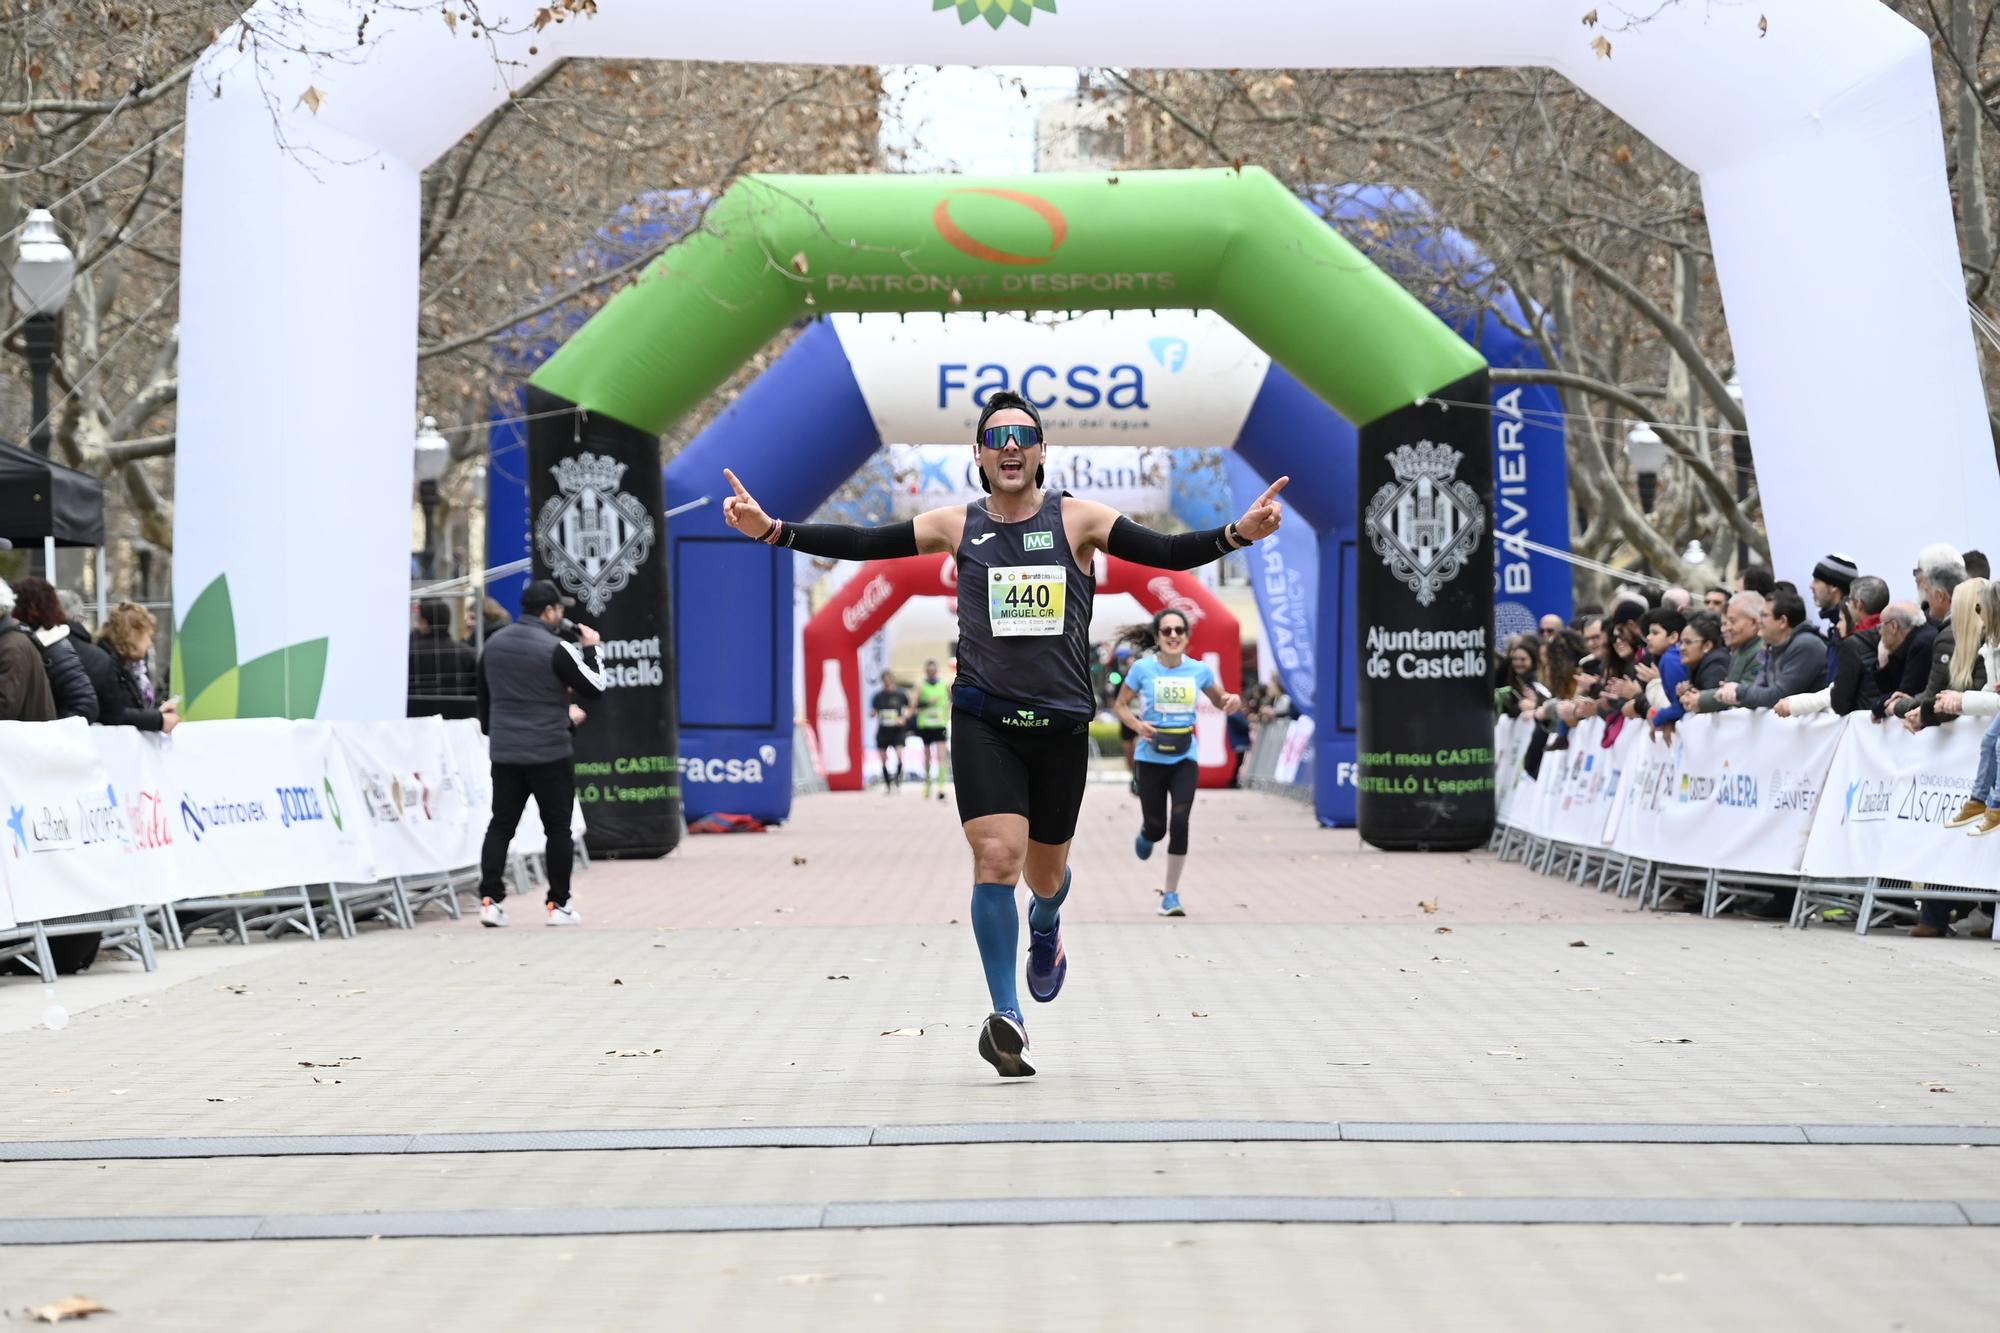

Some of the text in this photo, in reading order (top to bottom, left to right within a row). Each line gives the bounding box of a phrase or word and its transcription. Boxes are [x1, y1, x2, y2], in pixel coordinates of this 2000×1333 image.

[826, 271, 1175, 293] PATRONAT D'ESPORTS
[1496, 387, 1532, 594] BAVIERA
[1026, 535, 1051, 548] MC
[1005, 584, 1050, 608] 440
[1001, 608, 1055, 618] MIGUEL C/R
[1366, 625, 1486, 656] Ajuntament
[606, 659, 663, 688] stelló
[1366, 649, 1487, 680] de Castelló
[1163, 686, 1186, 699] 853
[1394, 753, 1433, 767] mou
[1423, 777, 1484, 796] L'esport
